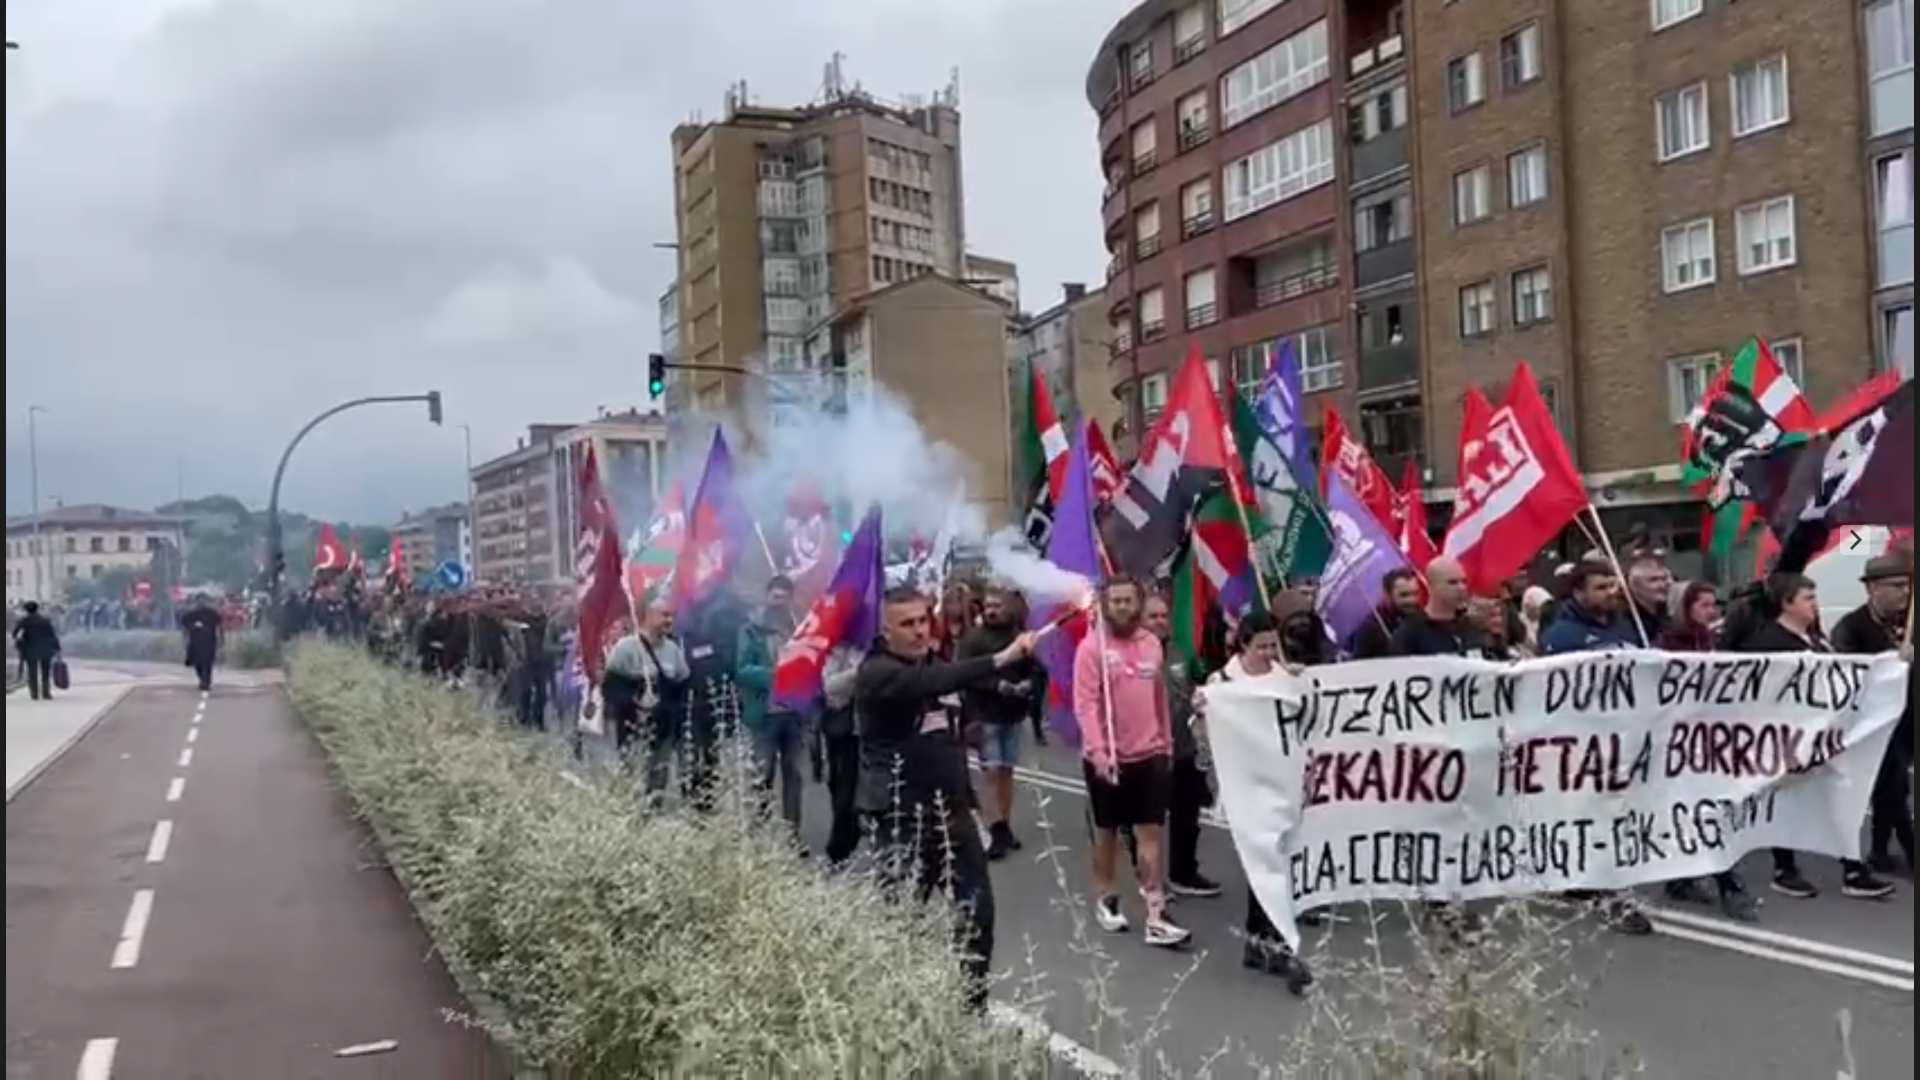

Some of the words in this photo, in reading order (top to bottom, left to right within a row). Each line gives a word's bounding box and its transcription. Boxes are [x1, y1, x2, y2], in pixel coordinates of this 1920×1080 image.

[1274, 670, 1516, 756] HITZARMEN
[1545, 653, 1636, 715] DUIN
[1658, 658, 1770, 706] BATEN
[1497, 730, 1652, 796] METALA
